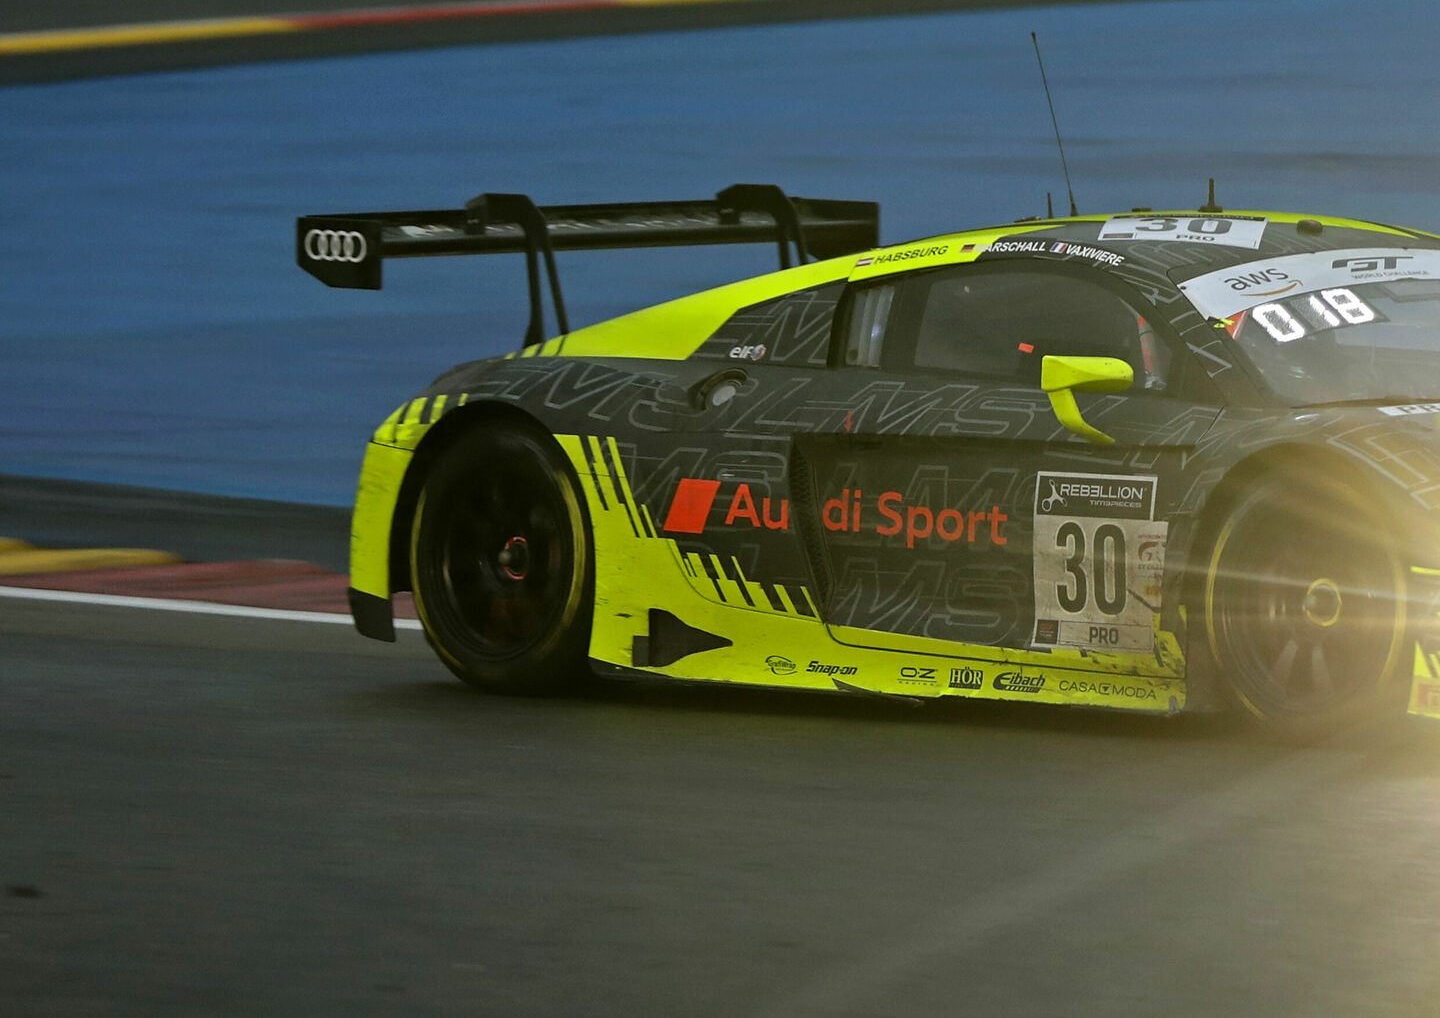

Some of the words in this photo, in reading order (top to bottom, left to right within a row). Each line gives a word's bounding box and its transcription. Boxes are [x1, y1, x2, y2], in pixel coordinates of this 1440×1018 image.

[1135, 218, 1233, 235] 30
[1175, 234, 1215, 242] PRO
[873, 245, 949, 265] HABSBURG
[1064, 243, 1126, 267] VAXIVIERE
[1224, 268, 1289, 291] aws
[1252, 288, 1375, 342] 018
[729, 345, 754, 359] elf
[1060, 484, 1143, 499] REBELLION
[876, 491, 1008, 549] Sport
[1056, 522, 1126, 616] 30
[1089, 627, 1119, 644] PRO
[806, 661, 858, 676] Snap-on
[951, 667, 982, 684] HÖR
[993, 672, 1045, 689] Eibach
[1058, 680, 1097, 692] CASA
[1112, 686, 1157, 700] MODA
